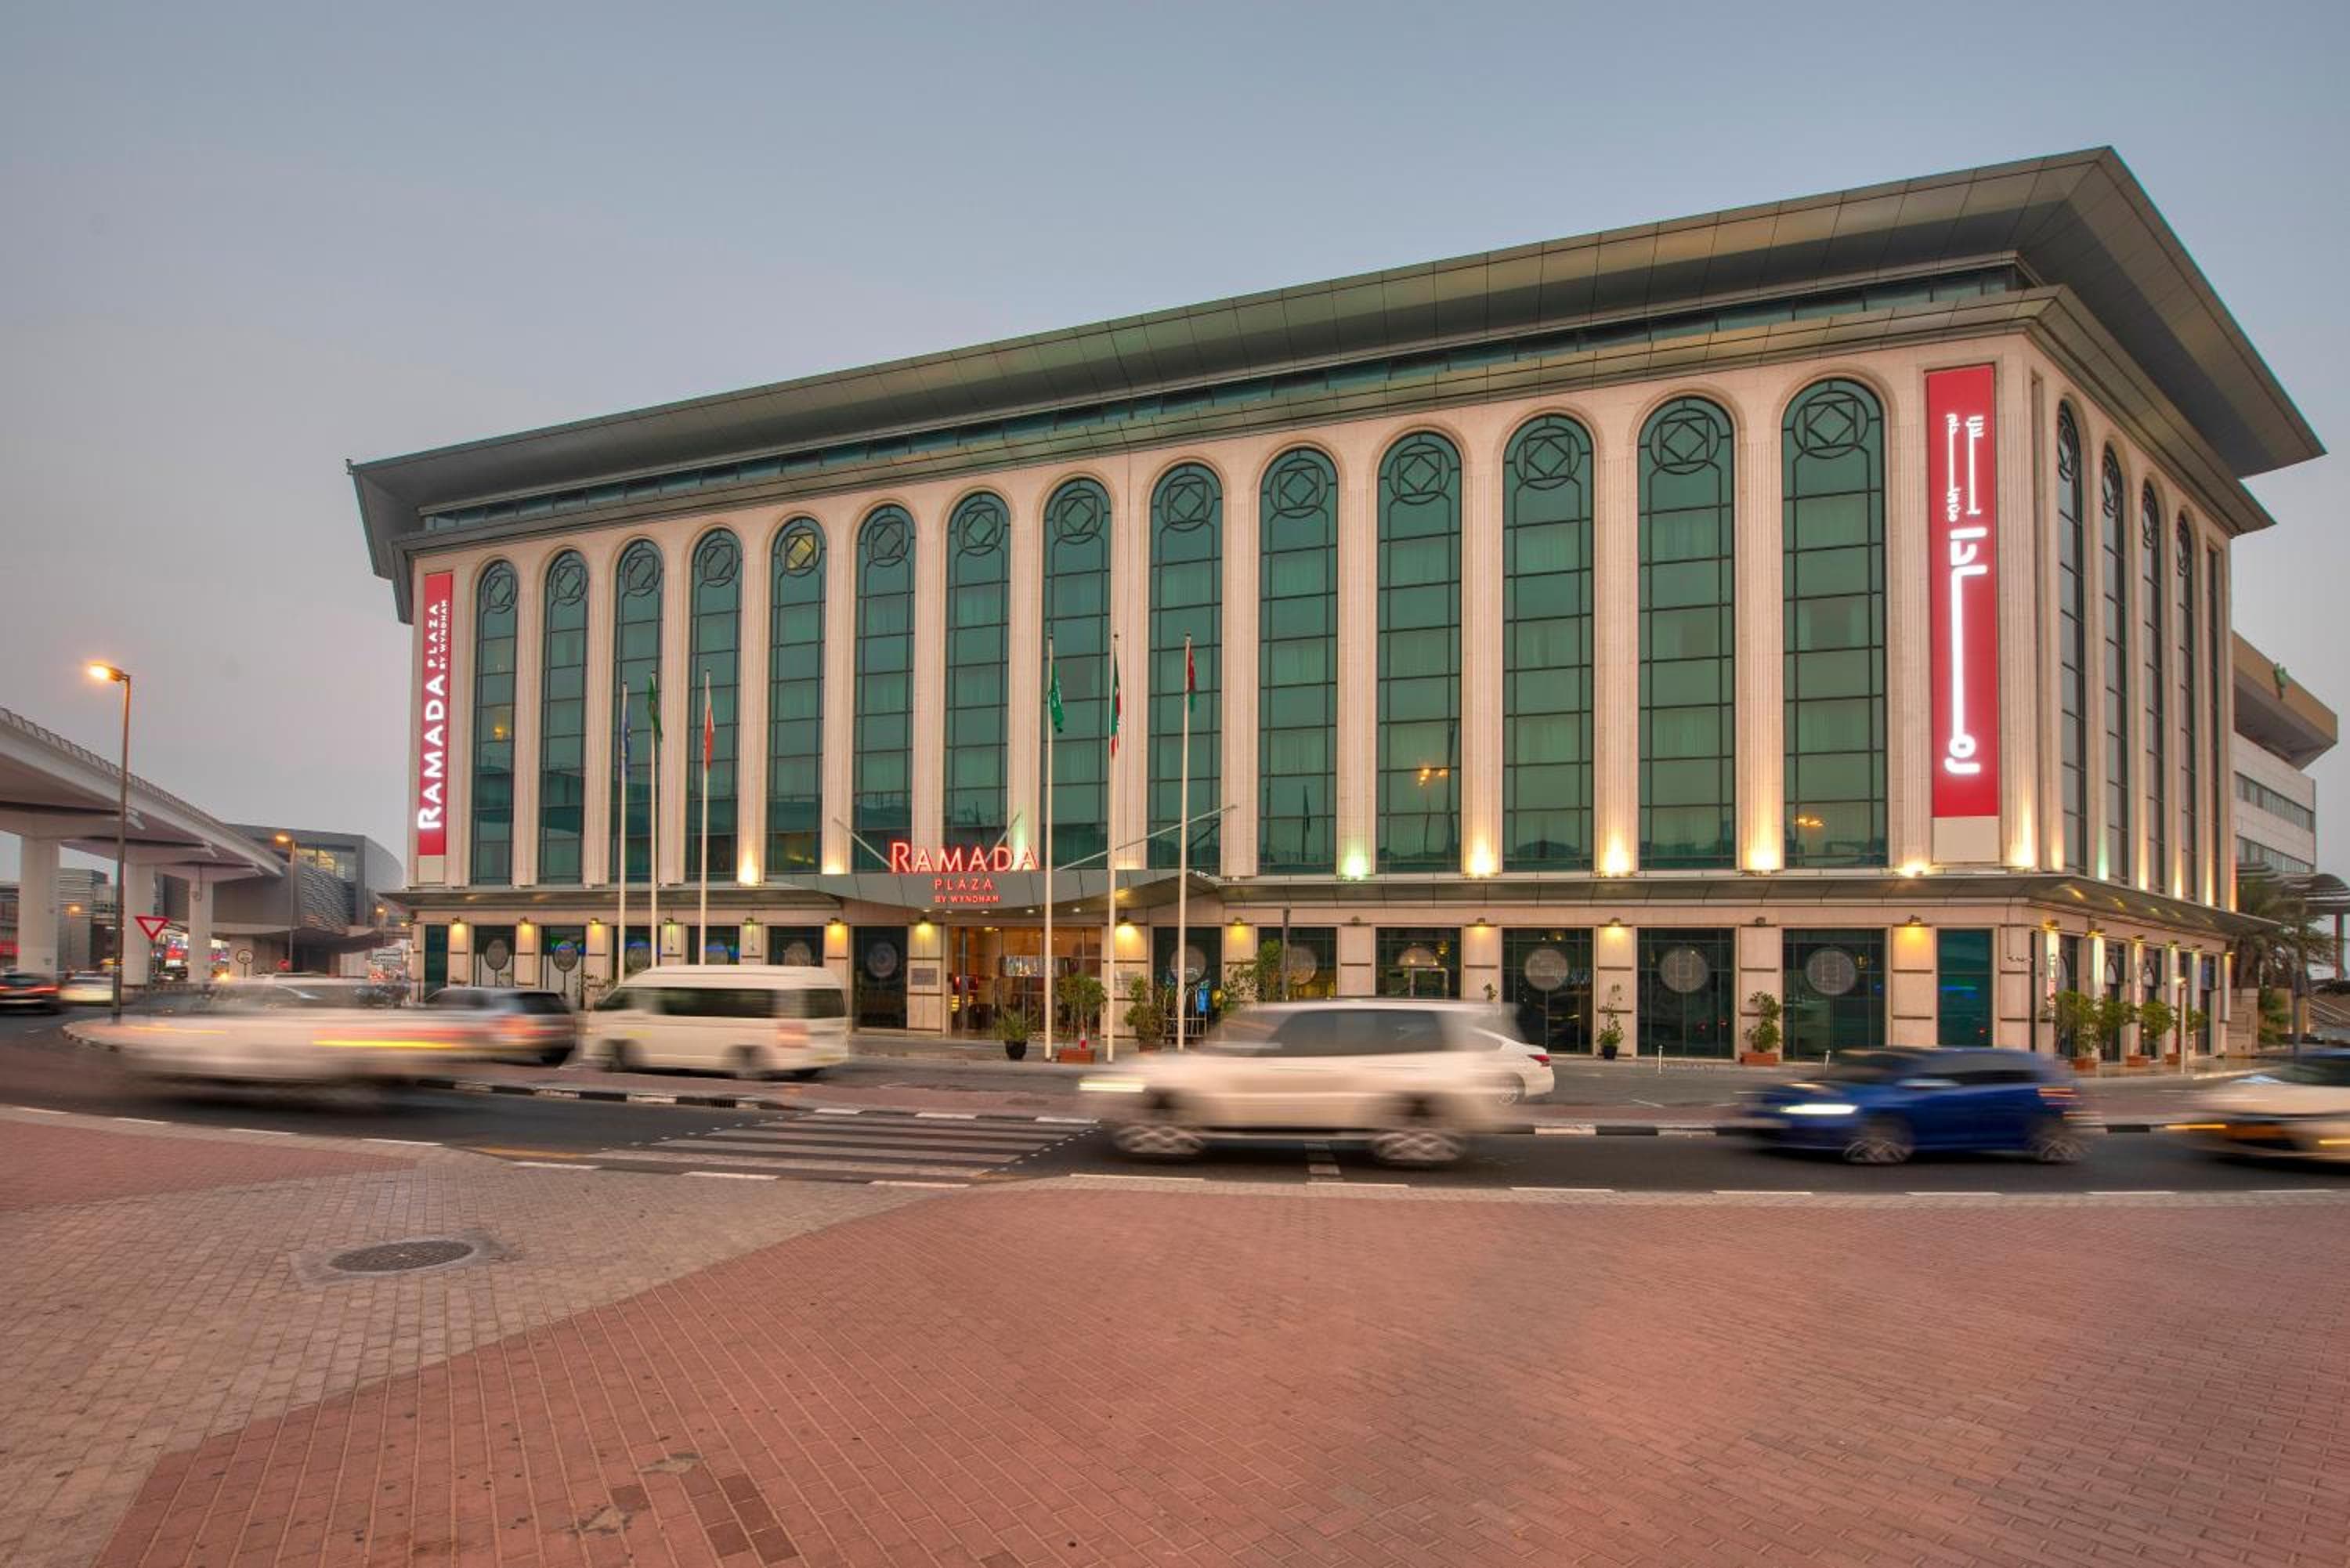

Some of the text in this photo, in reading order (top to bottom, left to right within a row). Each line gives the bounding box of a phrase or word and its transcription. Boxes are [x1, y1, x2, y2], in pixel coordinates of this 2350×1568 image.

[427, 604, 439, 668] PLAZA
[439, 599, 448, 670] BY WYNDHAM
[1943, 526, 1988, 776] رمادا
[417, 674, 445, 830] RAMADA
[891, 840, 1040, 873] RAMADA
[935, 878, 993, 890] PLAZA
